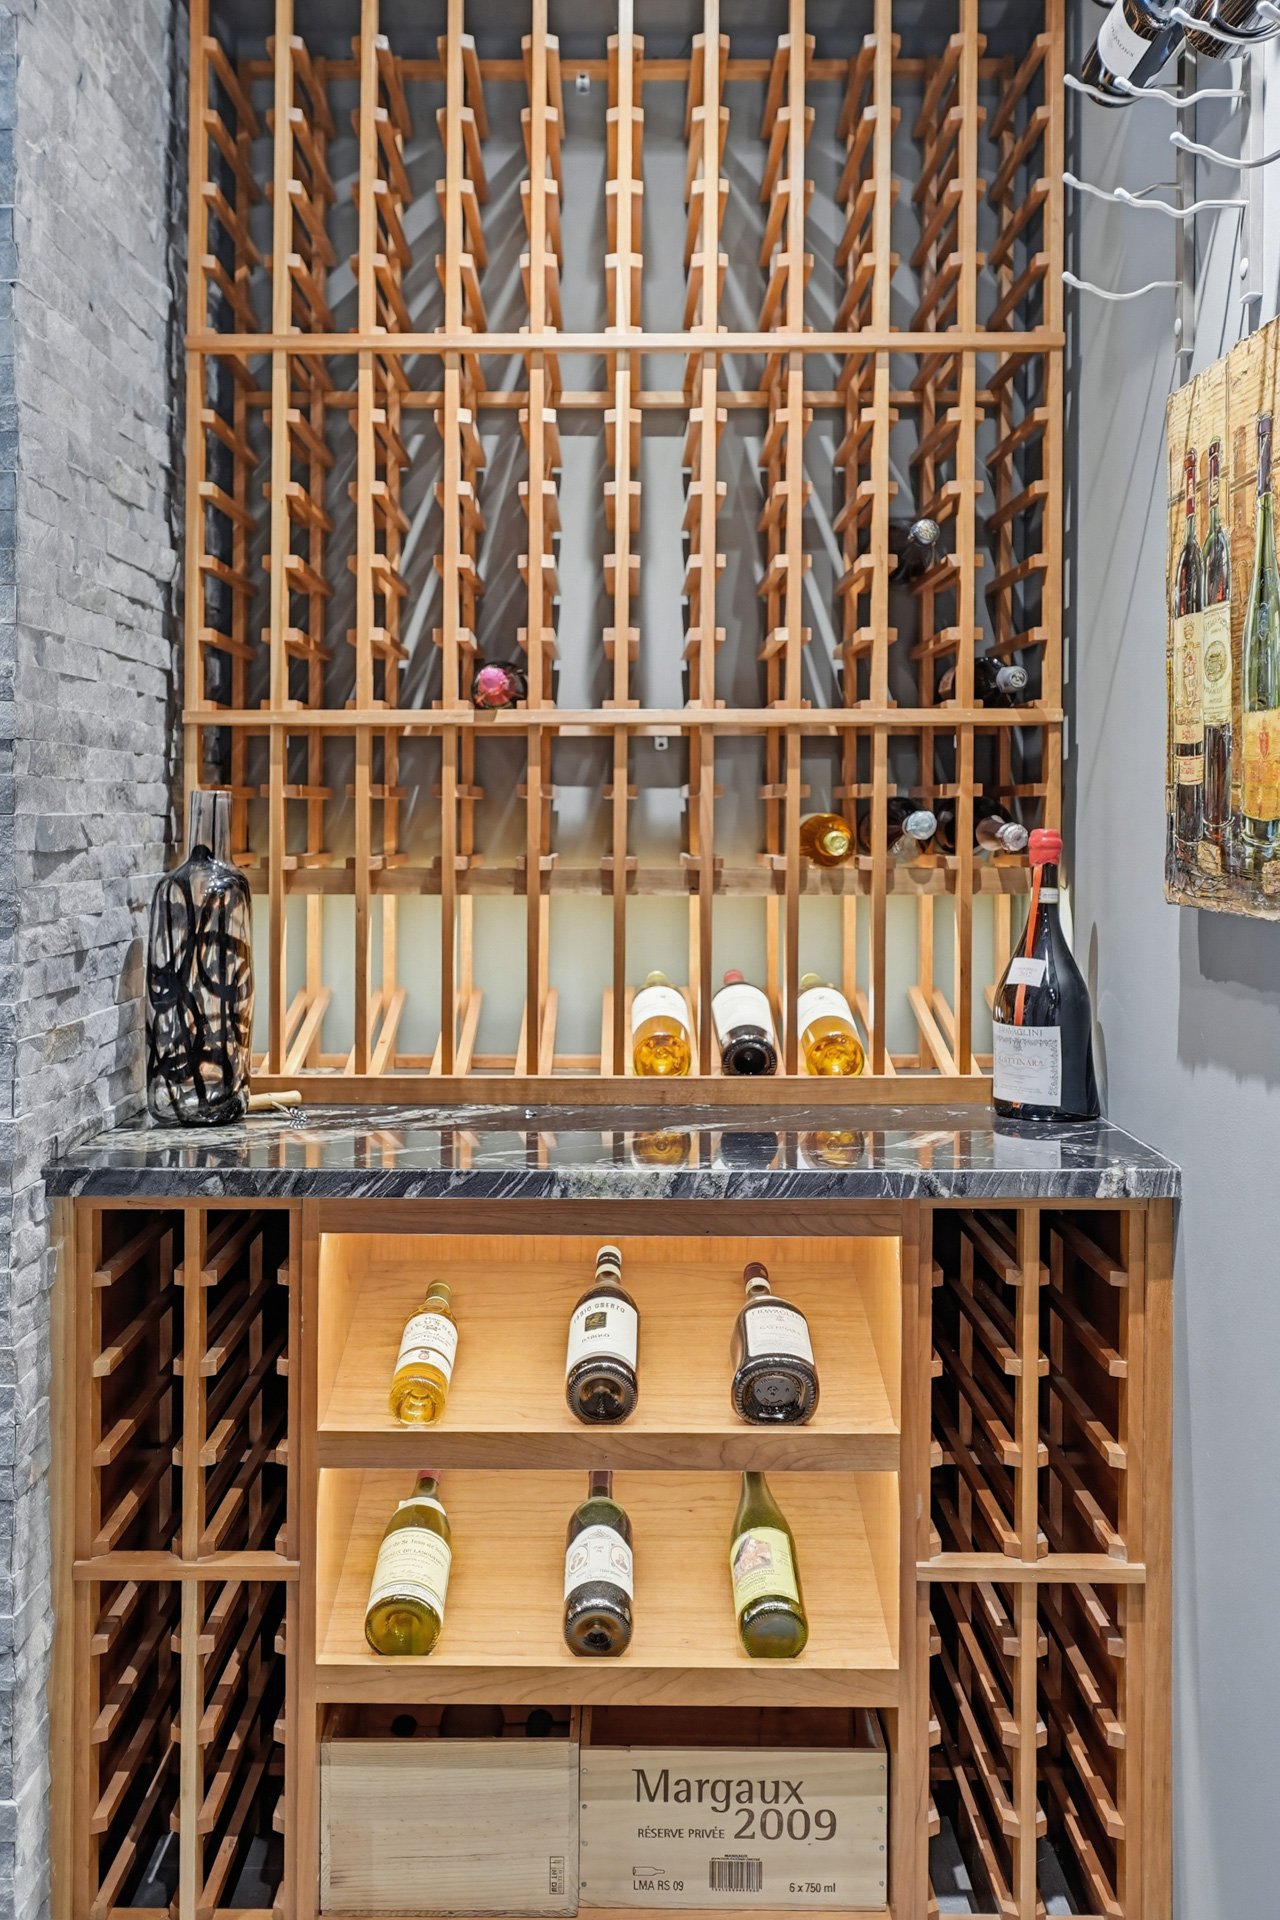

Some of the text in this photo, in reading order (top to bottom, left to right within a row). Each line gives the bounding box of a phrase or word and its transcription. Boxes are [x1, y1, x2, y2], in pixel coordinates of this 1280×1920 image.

[632, 1768, 804, 1813] Margaux
[734, 1808, 837, 1841] 2009
[637, 1825, 725, 1839] RÉSERVE PRIVÉE
[633, 1880, 684, 1891] LMA RS 09
[789, 1882, 836, 1893] 6 x 750 ml
